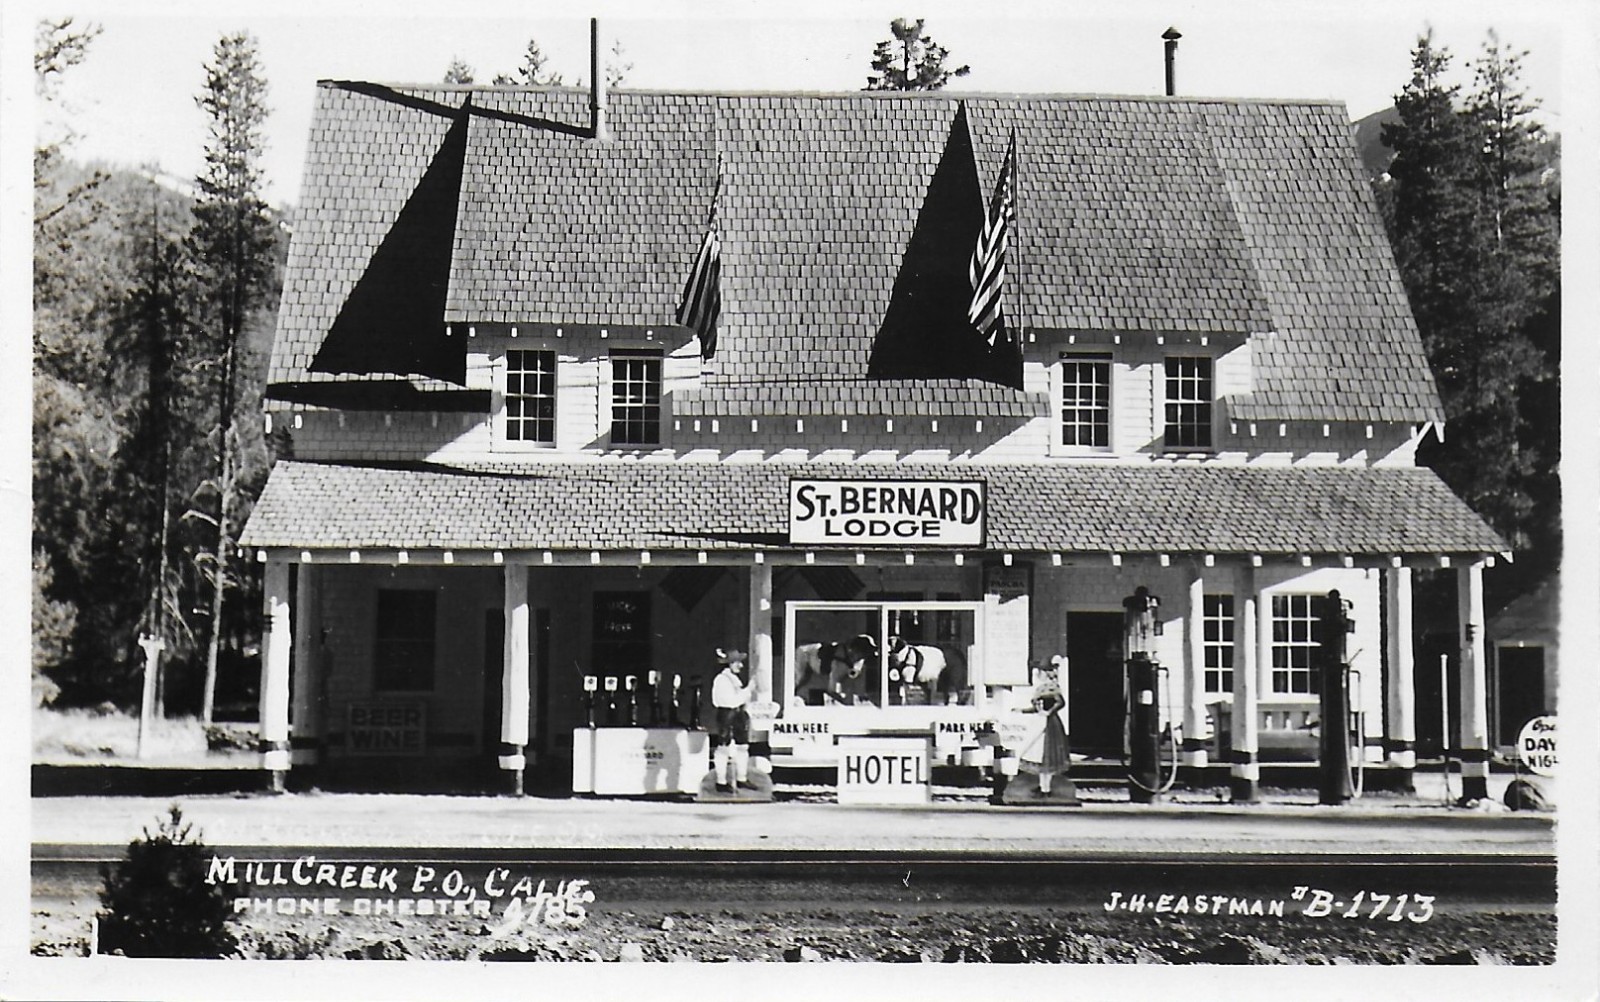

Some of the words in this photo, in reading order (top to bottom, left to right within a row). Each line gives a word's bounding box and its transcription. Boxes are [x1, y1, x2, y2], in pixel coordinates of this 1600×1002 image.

[796, 485, 838, 522] ST.
[840, 487, 980, 524] BERNARD
[824, 521, 941, 537] LODGE
[352, 708, 421, 727] BEER
[772, 723, 799, 733] PARK
[803, 723, 829, 733] HERE
[939, 722, 966, 733] PARK
[351, 730, 422, 748] WINE
[1525, 738, 1556, 751] DAY
[846, 755, 928, 784] HOTEL
